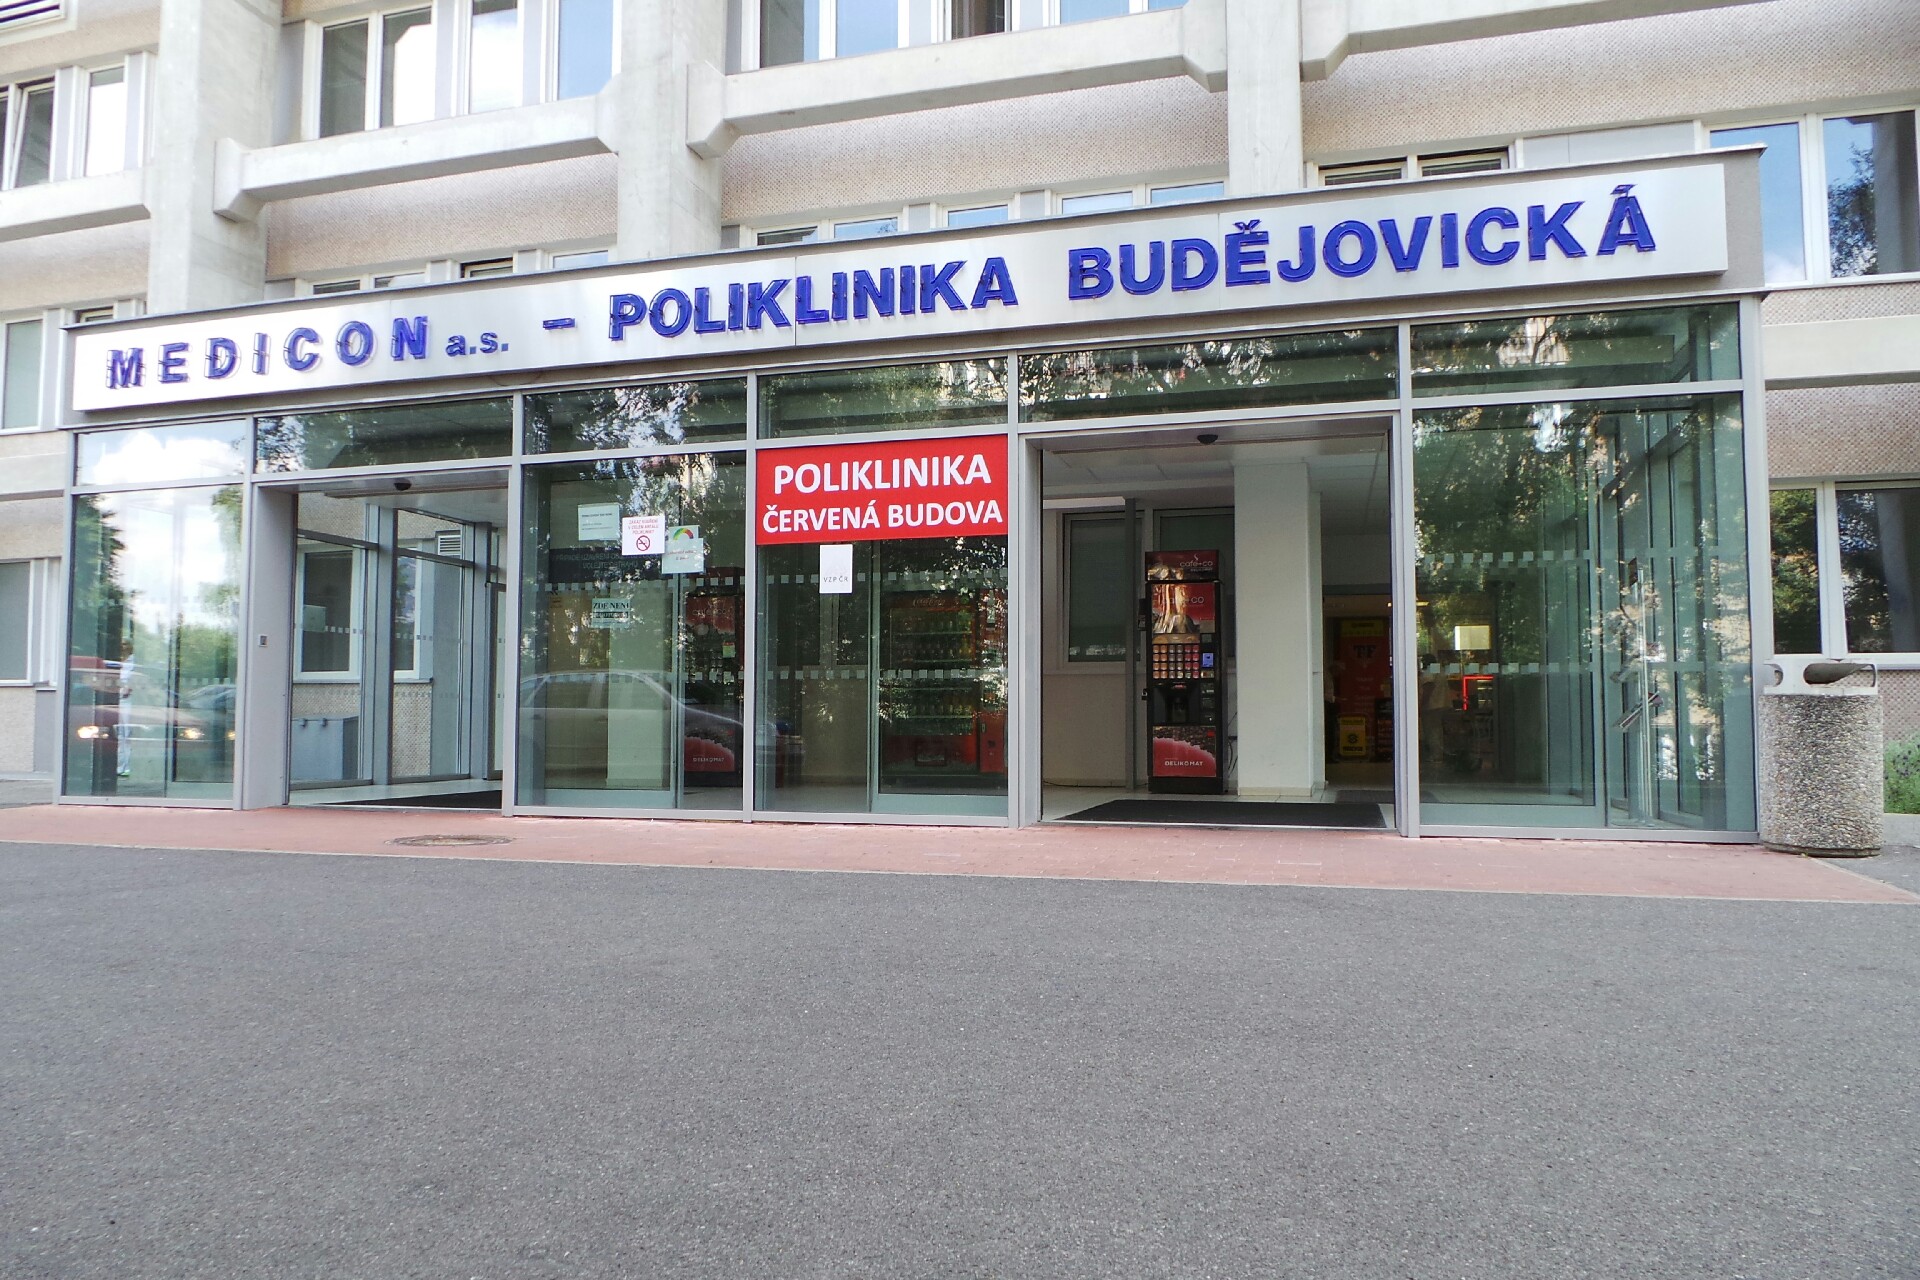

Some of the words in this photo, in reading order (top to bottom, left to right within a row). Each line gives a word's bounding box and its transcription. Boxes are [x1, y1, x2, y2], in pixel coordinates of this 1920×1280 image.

[106, 316, 428, 390] MEDICON
[445, 331, 509, 357] a.s.
[609, 256, 1019, 342] POLIKLINIKA
[1068, 184, 1657, 301] BUDĚJOVICKÁ
[774, 453, 992, 495] POLIKLINIKA
[762, 499, 881, 534] ČERVENÁ
[888, 499, 1003, 528] BUDOVA
